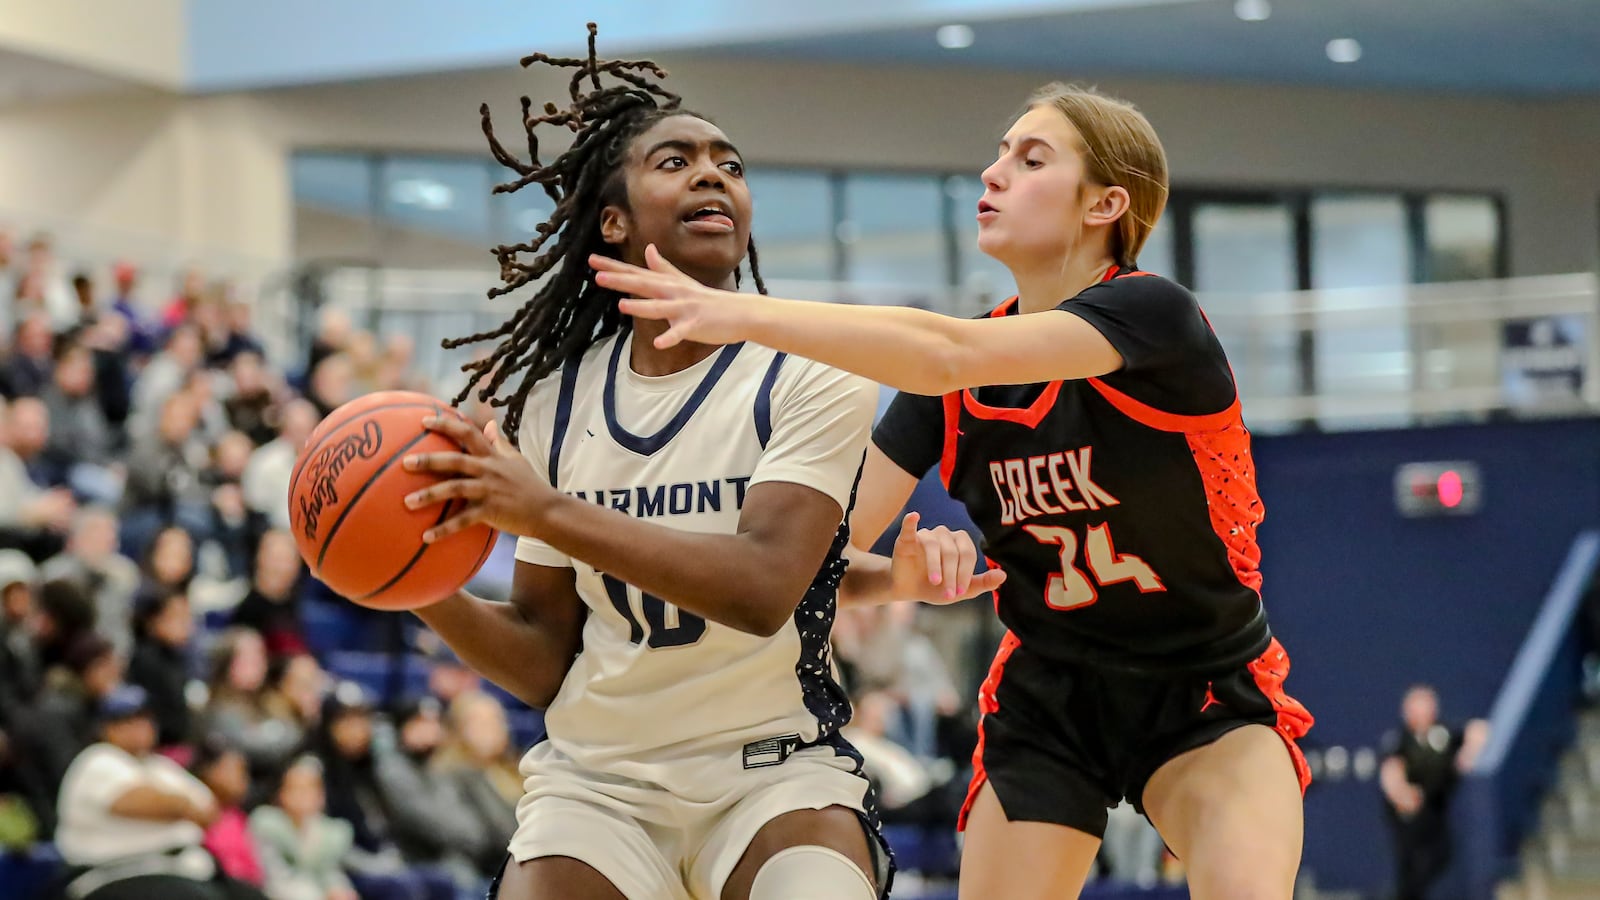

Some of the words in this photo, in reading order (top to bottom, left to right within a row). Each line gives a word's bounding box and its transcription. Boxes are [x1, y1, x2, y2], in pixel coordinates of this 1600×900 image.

[299, 419, 383, 541] Rawlings
[566, 476, 752, 518] IRMONT
[989, 446, 1121, 526] CREEK
[1021, 521, 1168, 611] 34
